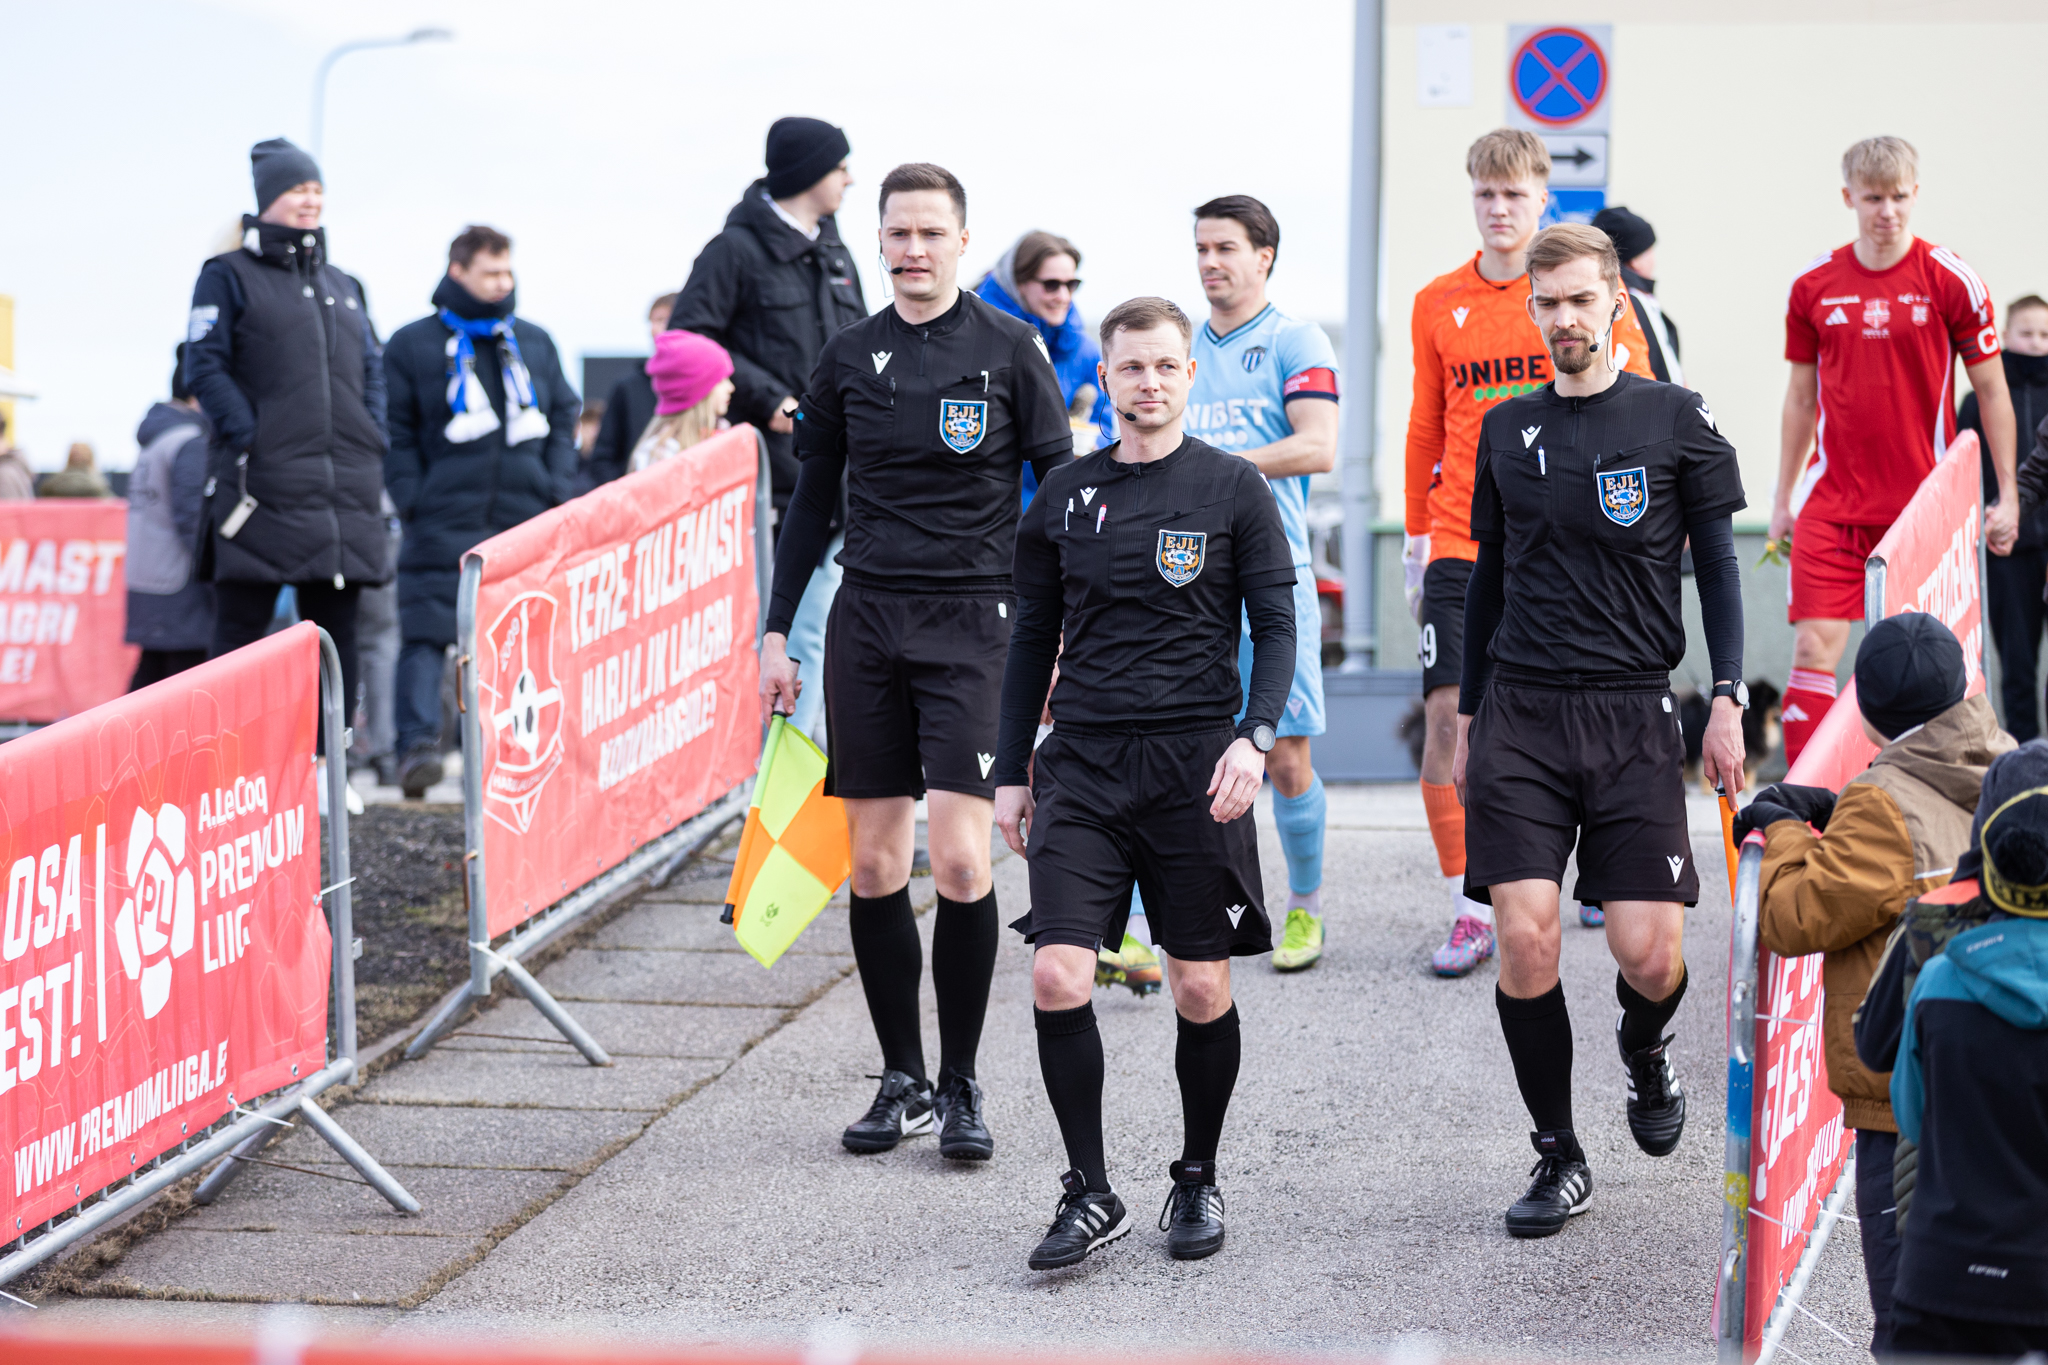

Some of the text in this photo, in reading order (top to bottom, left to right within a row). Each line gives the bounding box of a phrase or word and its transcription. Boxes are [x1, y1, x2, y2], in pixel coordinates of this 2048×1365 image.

[1977, 326, 1999, 355] C
[1452, 354, 1552, 388] UNIBE
[947, 405, 980, 419] EJL
[1182, 398, 1269, 431] NIBET
[1604, 474, 1640, 491] EJL
[1164, 535, 1199, 550] EJL
[565, 484, 749, 654] TERE TULEMAST
[0, 600, 79, 646] GRI
[1418, 622, 1437, 669] 9
[199, 775, 269, 834] A.LeCoq
[200, 804, 305, 907] PREMUM
[3, 833, 83, 962] OSA
[202, 898, 255, 975] LIIG
[14, 1036, 230, 1199] WWW.PREMIUMLIIGA.E
